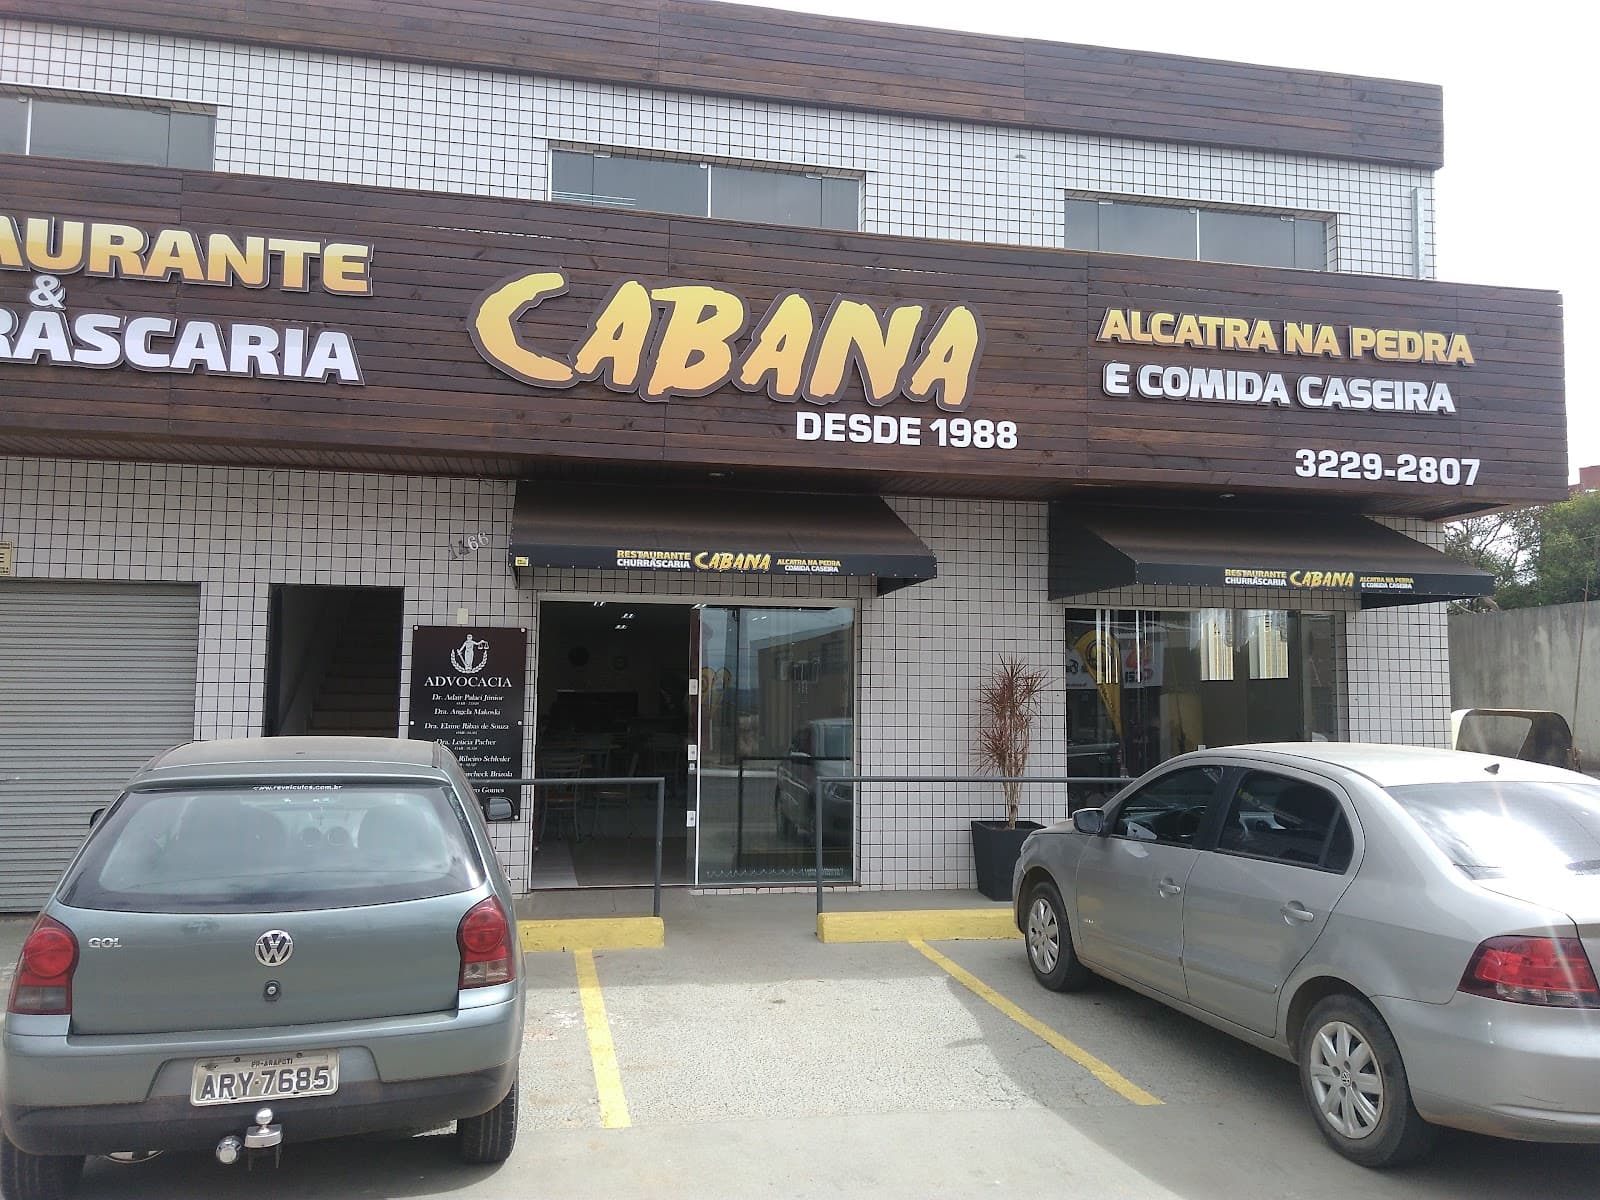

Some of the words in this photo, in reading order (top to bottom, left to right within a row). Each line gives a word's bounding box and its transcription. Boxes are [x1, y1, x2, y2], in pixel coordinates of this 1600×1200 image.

[29, 275, 65, 309] &
[472, 269, 980, 407] CABANA
[1097, 308, 1279, 353] ALCATRA
[1284, 322, 1342, 357] NA
[1350, 326, 1475, 365] PEDRA
[0, 309, 363, 384] ASCARIA
[1138, 364, 1290, 406] COMIDA
[1298, 375, 1456, 414] CASEIRA
[796, 412, 921, 446] DESDE
[929, 418, 1018, 449] 1988
[1295, 448, 1481, 487] 3229-2807
[616, 549, 692, 560] RESTAURANTE
[616, 559, 691, 569] CHURRASCARIA
[694, 551, 772, 572] CABANA
[776, 558, 806, 566] ALCATRA
[1224, 568, 1288, 579] RESTAURANTE
[1224, 576, 1288, 587] CHURRASCARIA
[1289, 570, 1355, 589] CABANA
[424, 676, 512, 688] ADVOCACIA
[432, 693, 443, 701] Dr.
[88, 937, 122, 948] GOL
